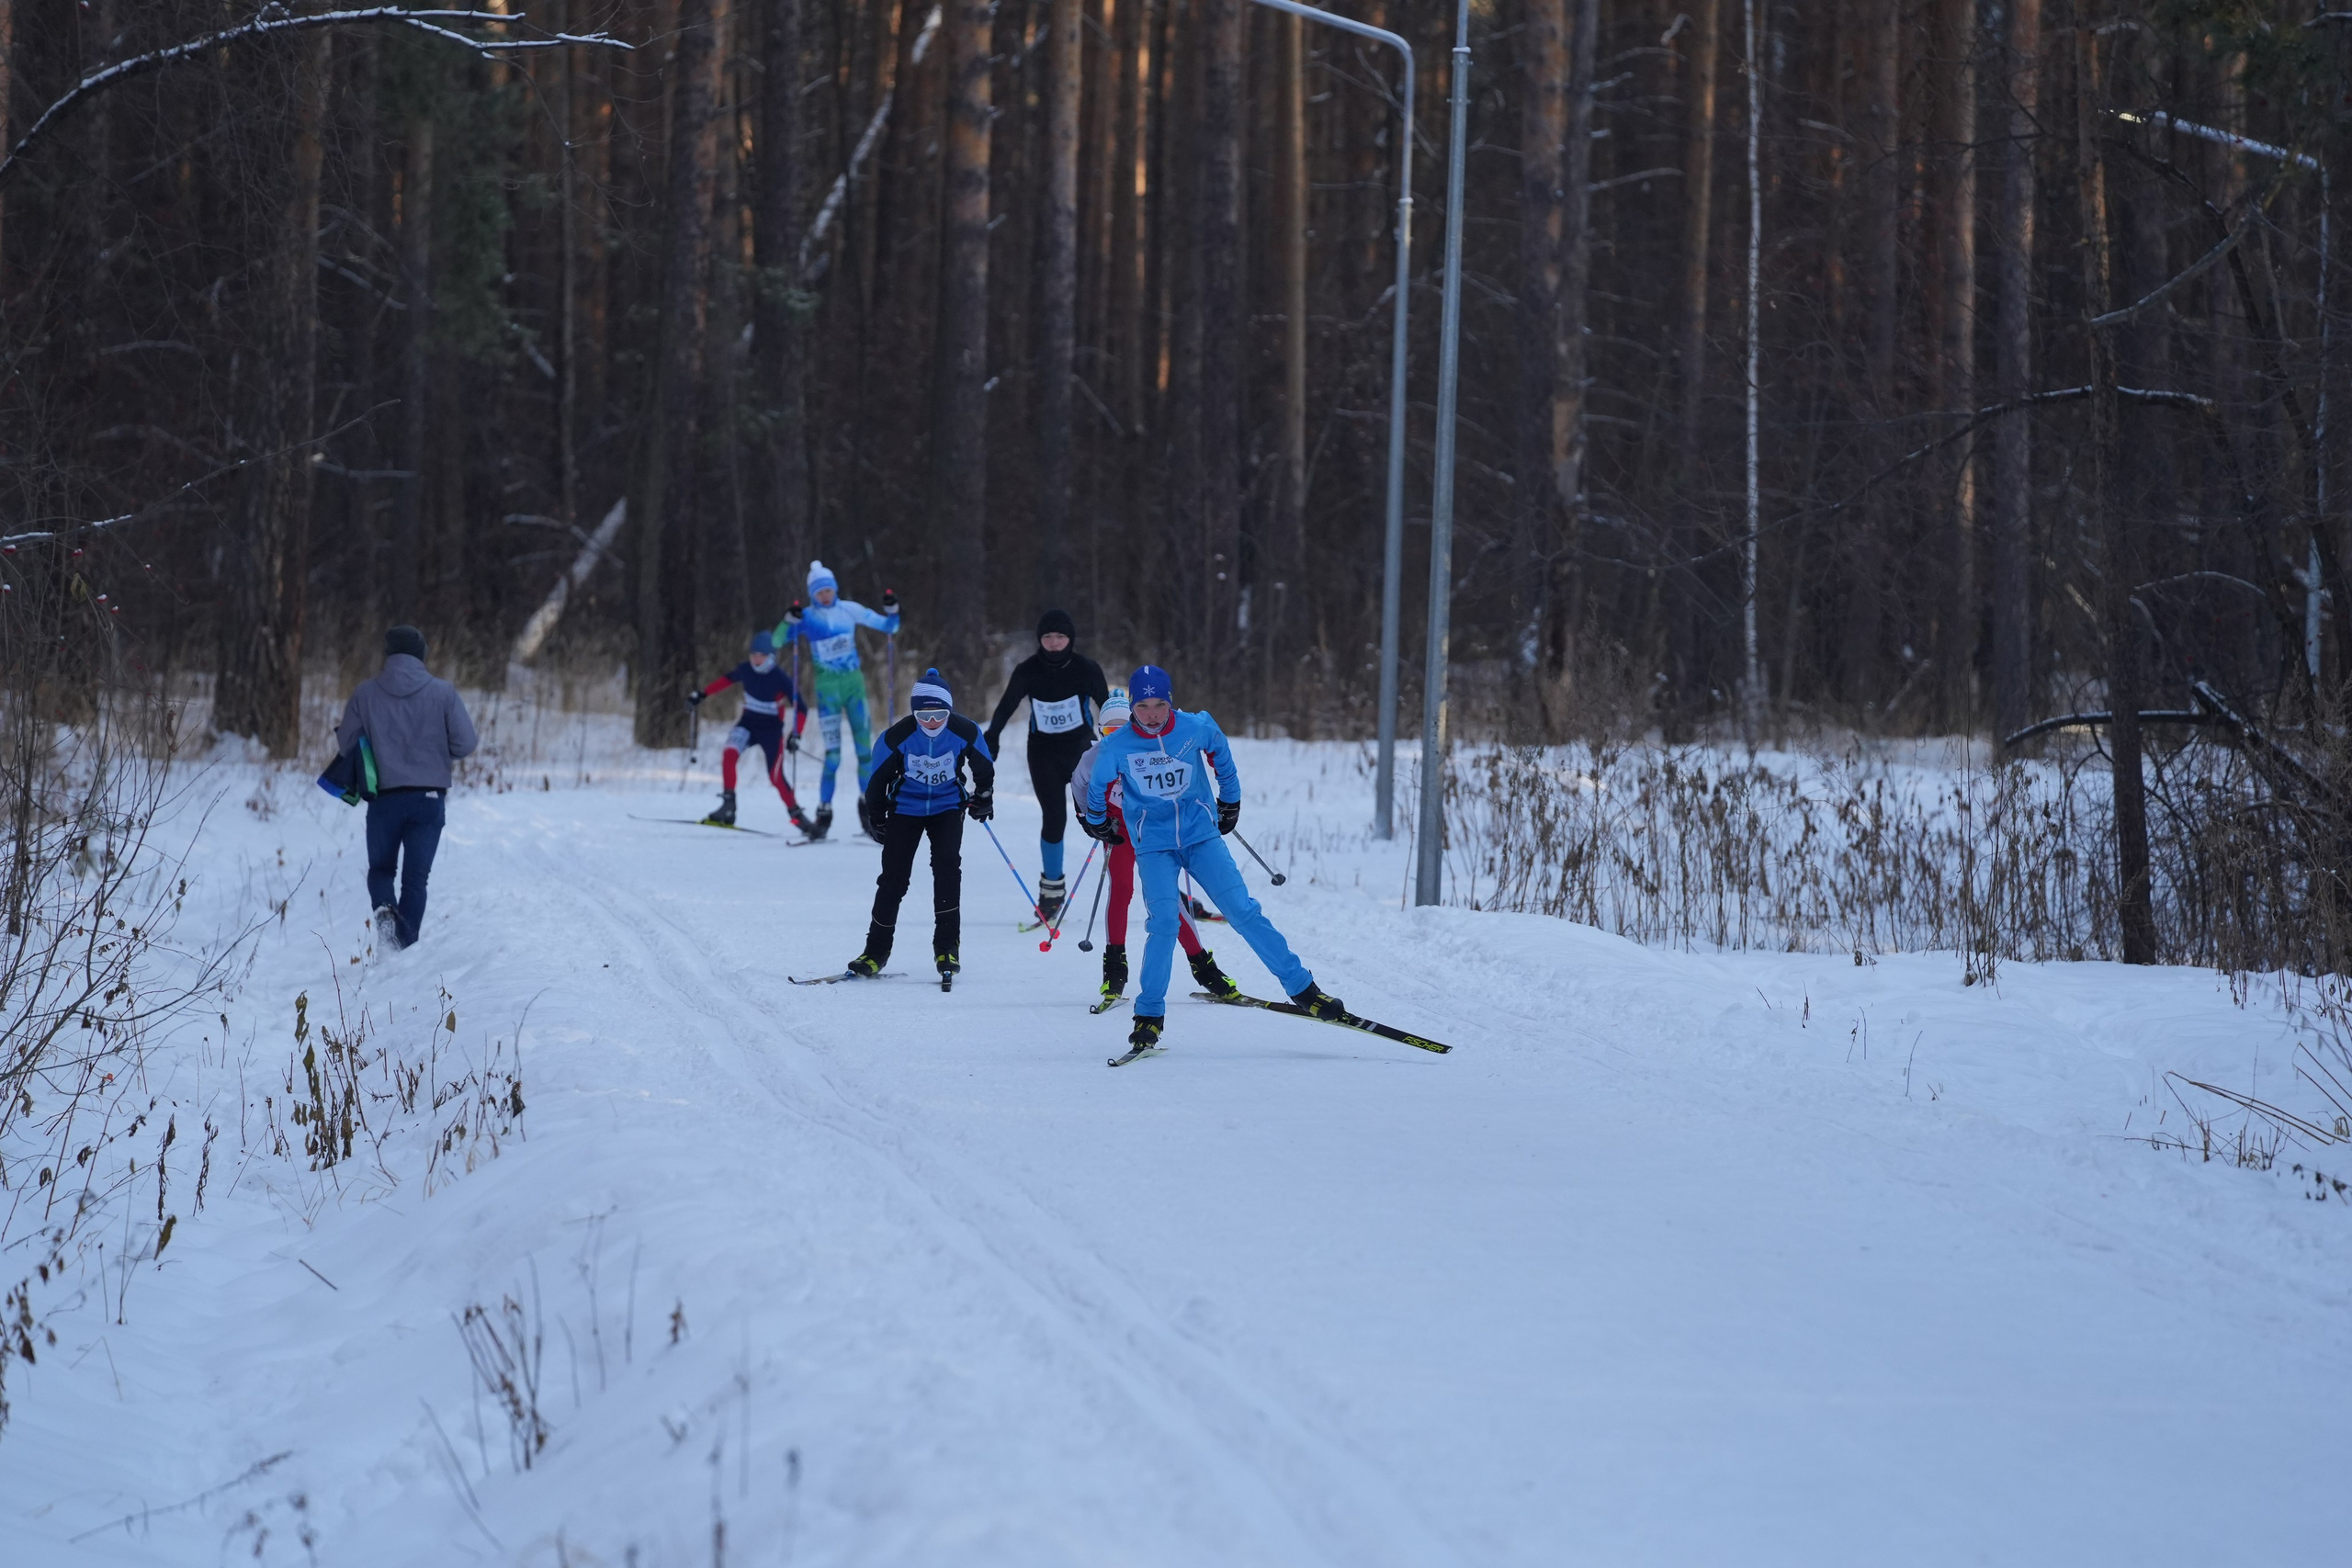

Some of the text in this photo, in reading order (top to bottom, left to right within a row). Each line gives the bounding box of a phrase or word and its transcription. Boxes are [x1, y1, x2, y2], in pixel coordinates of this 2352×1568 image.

[1043, 713, 1073, 726] 7091
[915, 770, 947, 784] 7186
[1143, 768, 1184, 789] 7197
[1402, 1035, 1444, 1053] FISCHER
